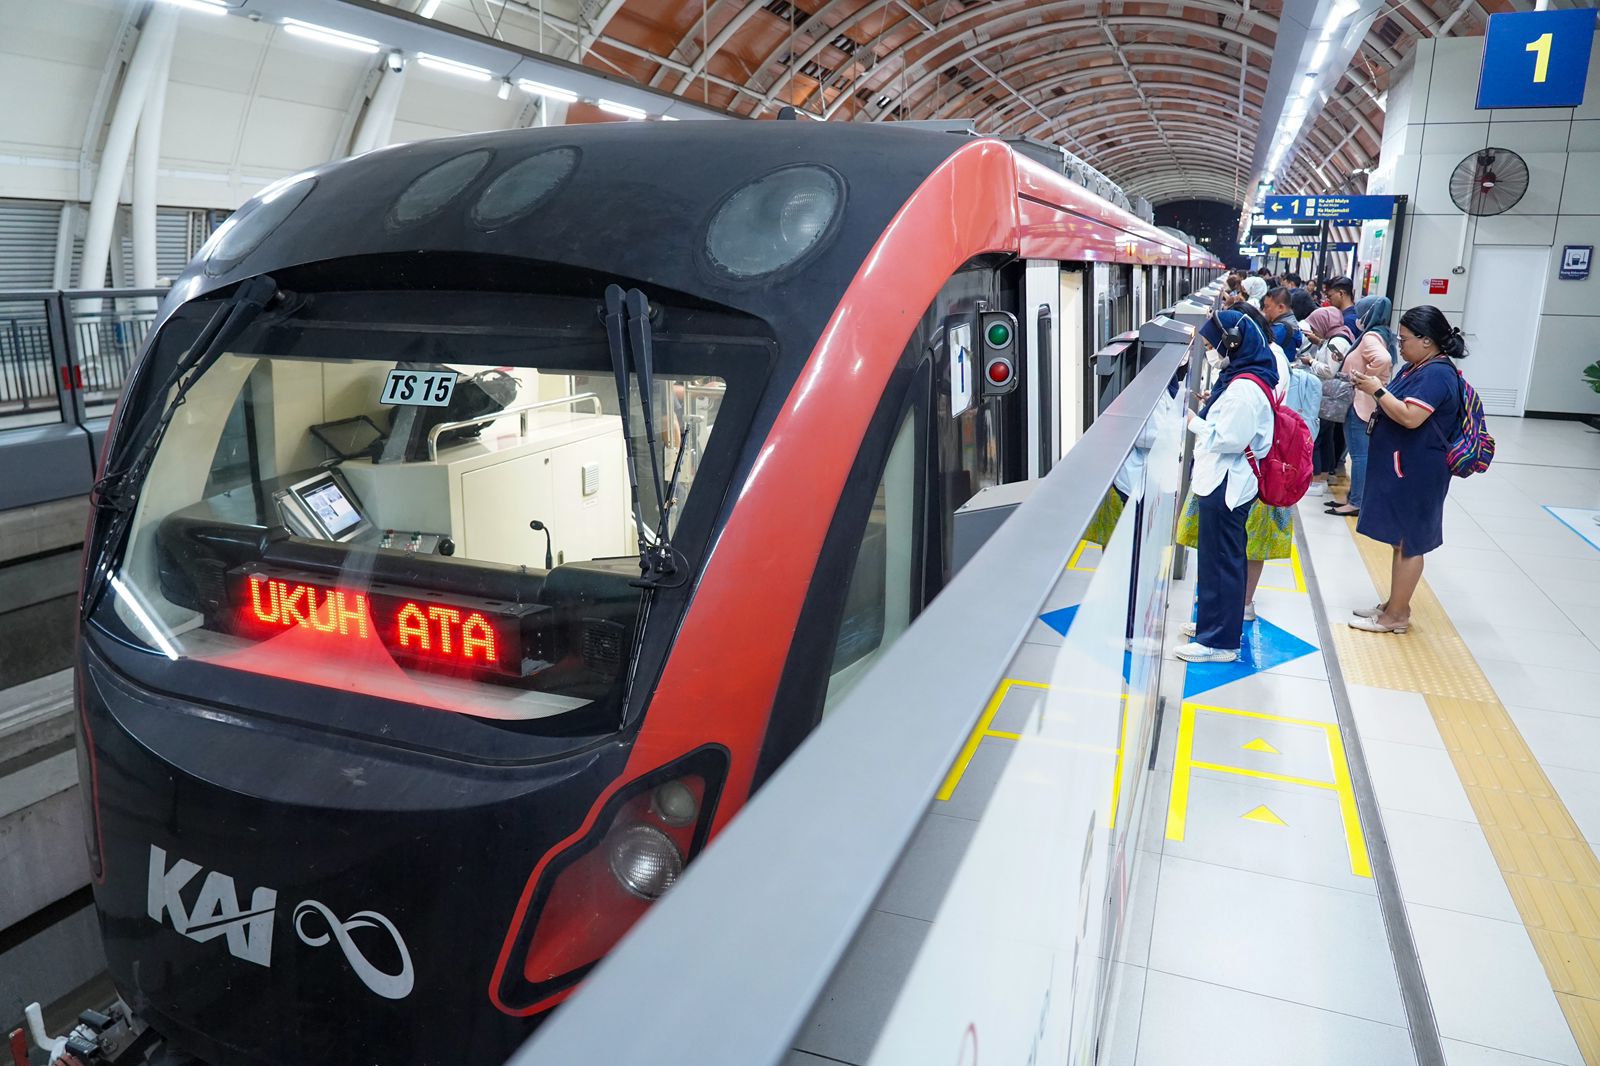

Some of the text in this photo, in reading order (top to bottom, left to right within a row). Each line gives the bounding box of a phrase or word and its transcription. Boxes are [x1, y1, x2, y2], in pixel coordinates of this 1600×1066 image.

[1525, 33, 1553, 83] 1
[1291, 199, 1299, 214] 1
[388, 374, 452, 402] TS 15
[249, 577, 496, 661] UKUH ATA
[147, 843, 278, 968] KAI
